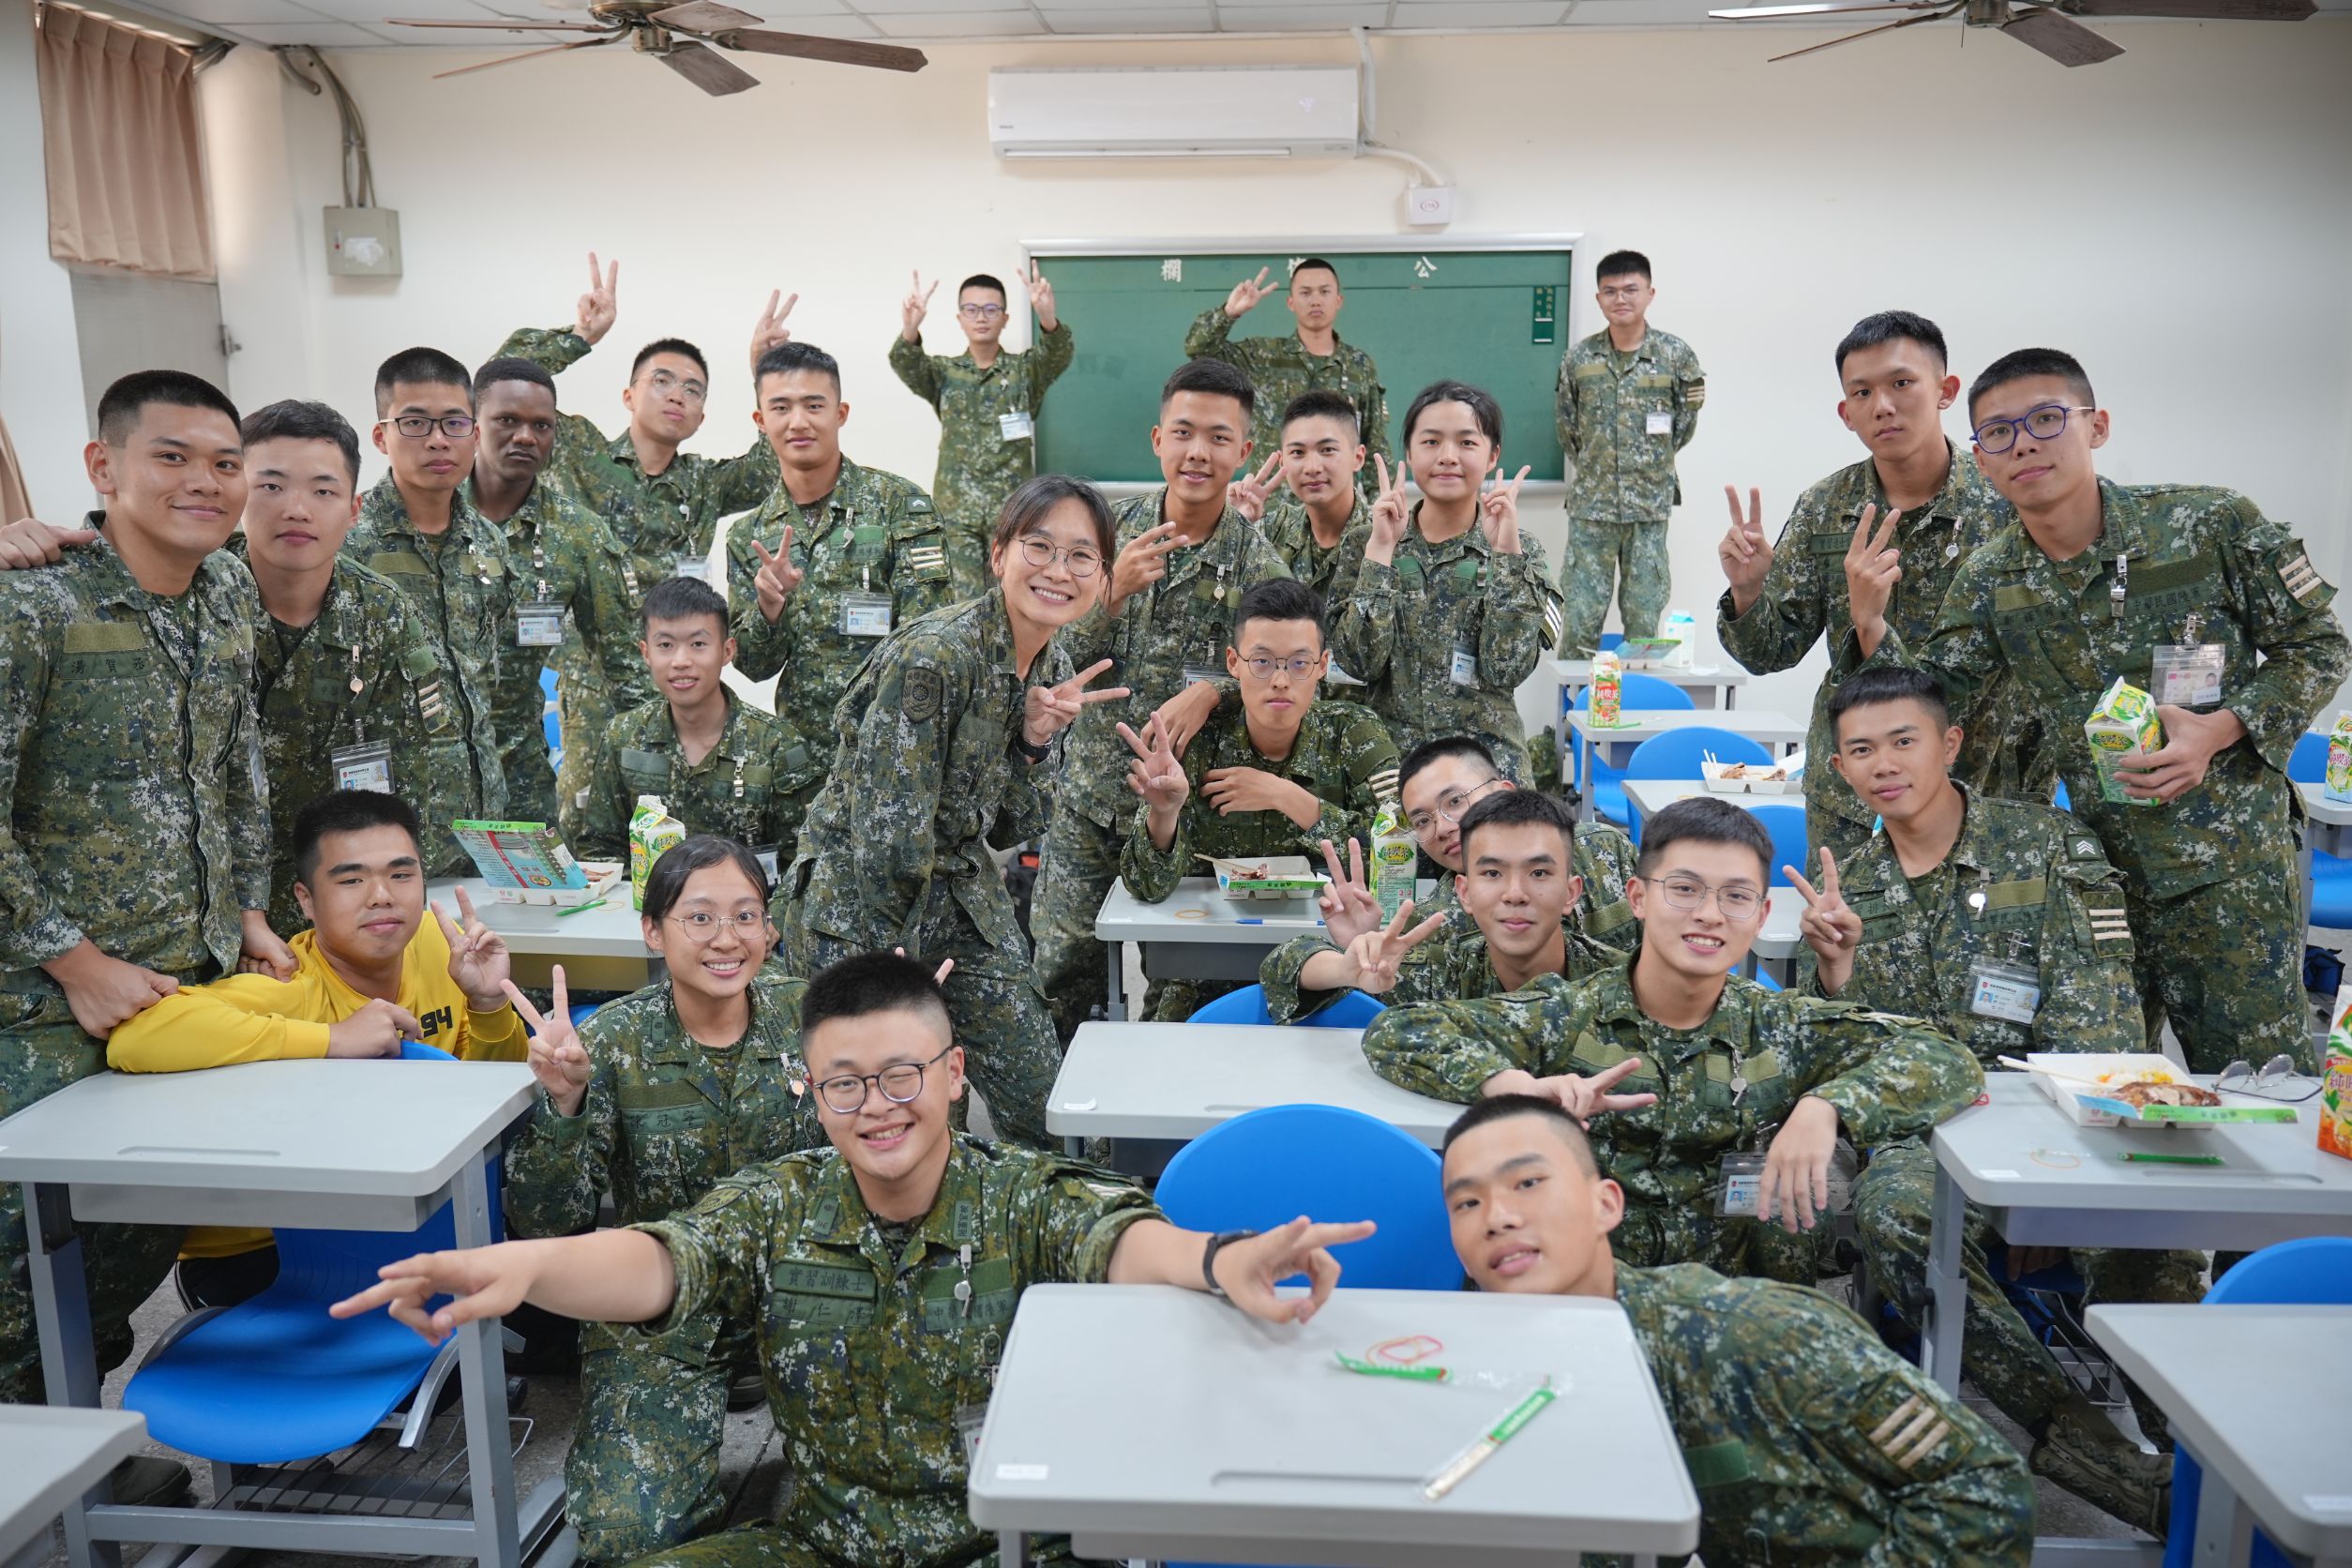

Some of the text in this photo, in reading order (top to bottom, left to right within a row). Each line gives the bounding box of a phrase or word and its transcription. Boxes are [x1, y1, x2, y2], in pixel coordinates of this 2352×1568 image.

[2133, 587, 2201, 610] 中華民國陸軍
[71, 657, 145, 674] 湯賀丞
[420, 1005, 453, 1038] 94
[789, 1267, 867, 1291] 實習訓練士
[934, 1300, 1007, 1321] 中華國陸軍
